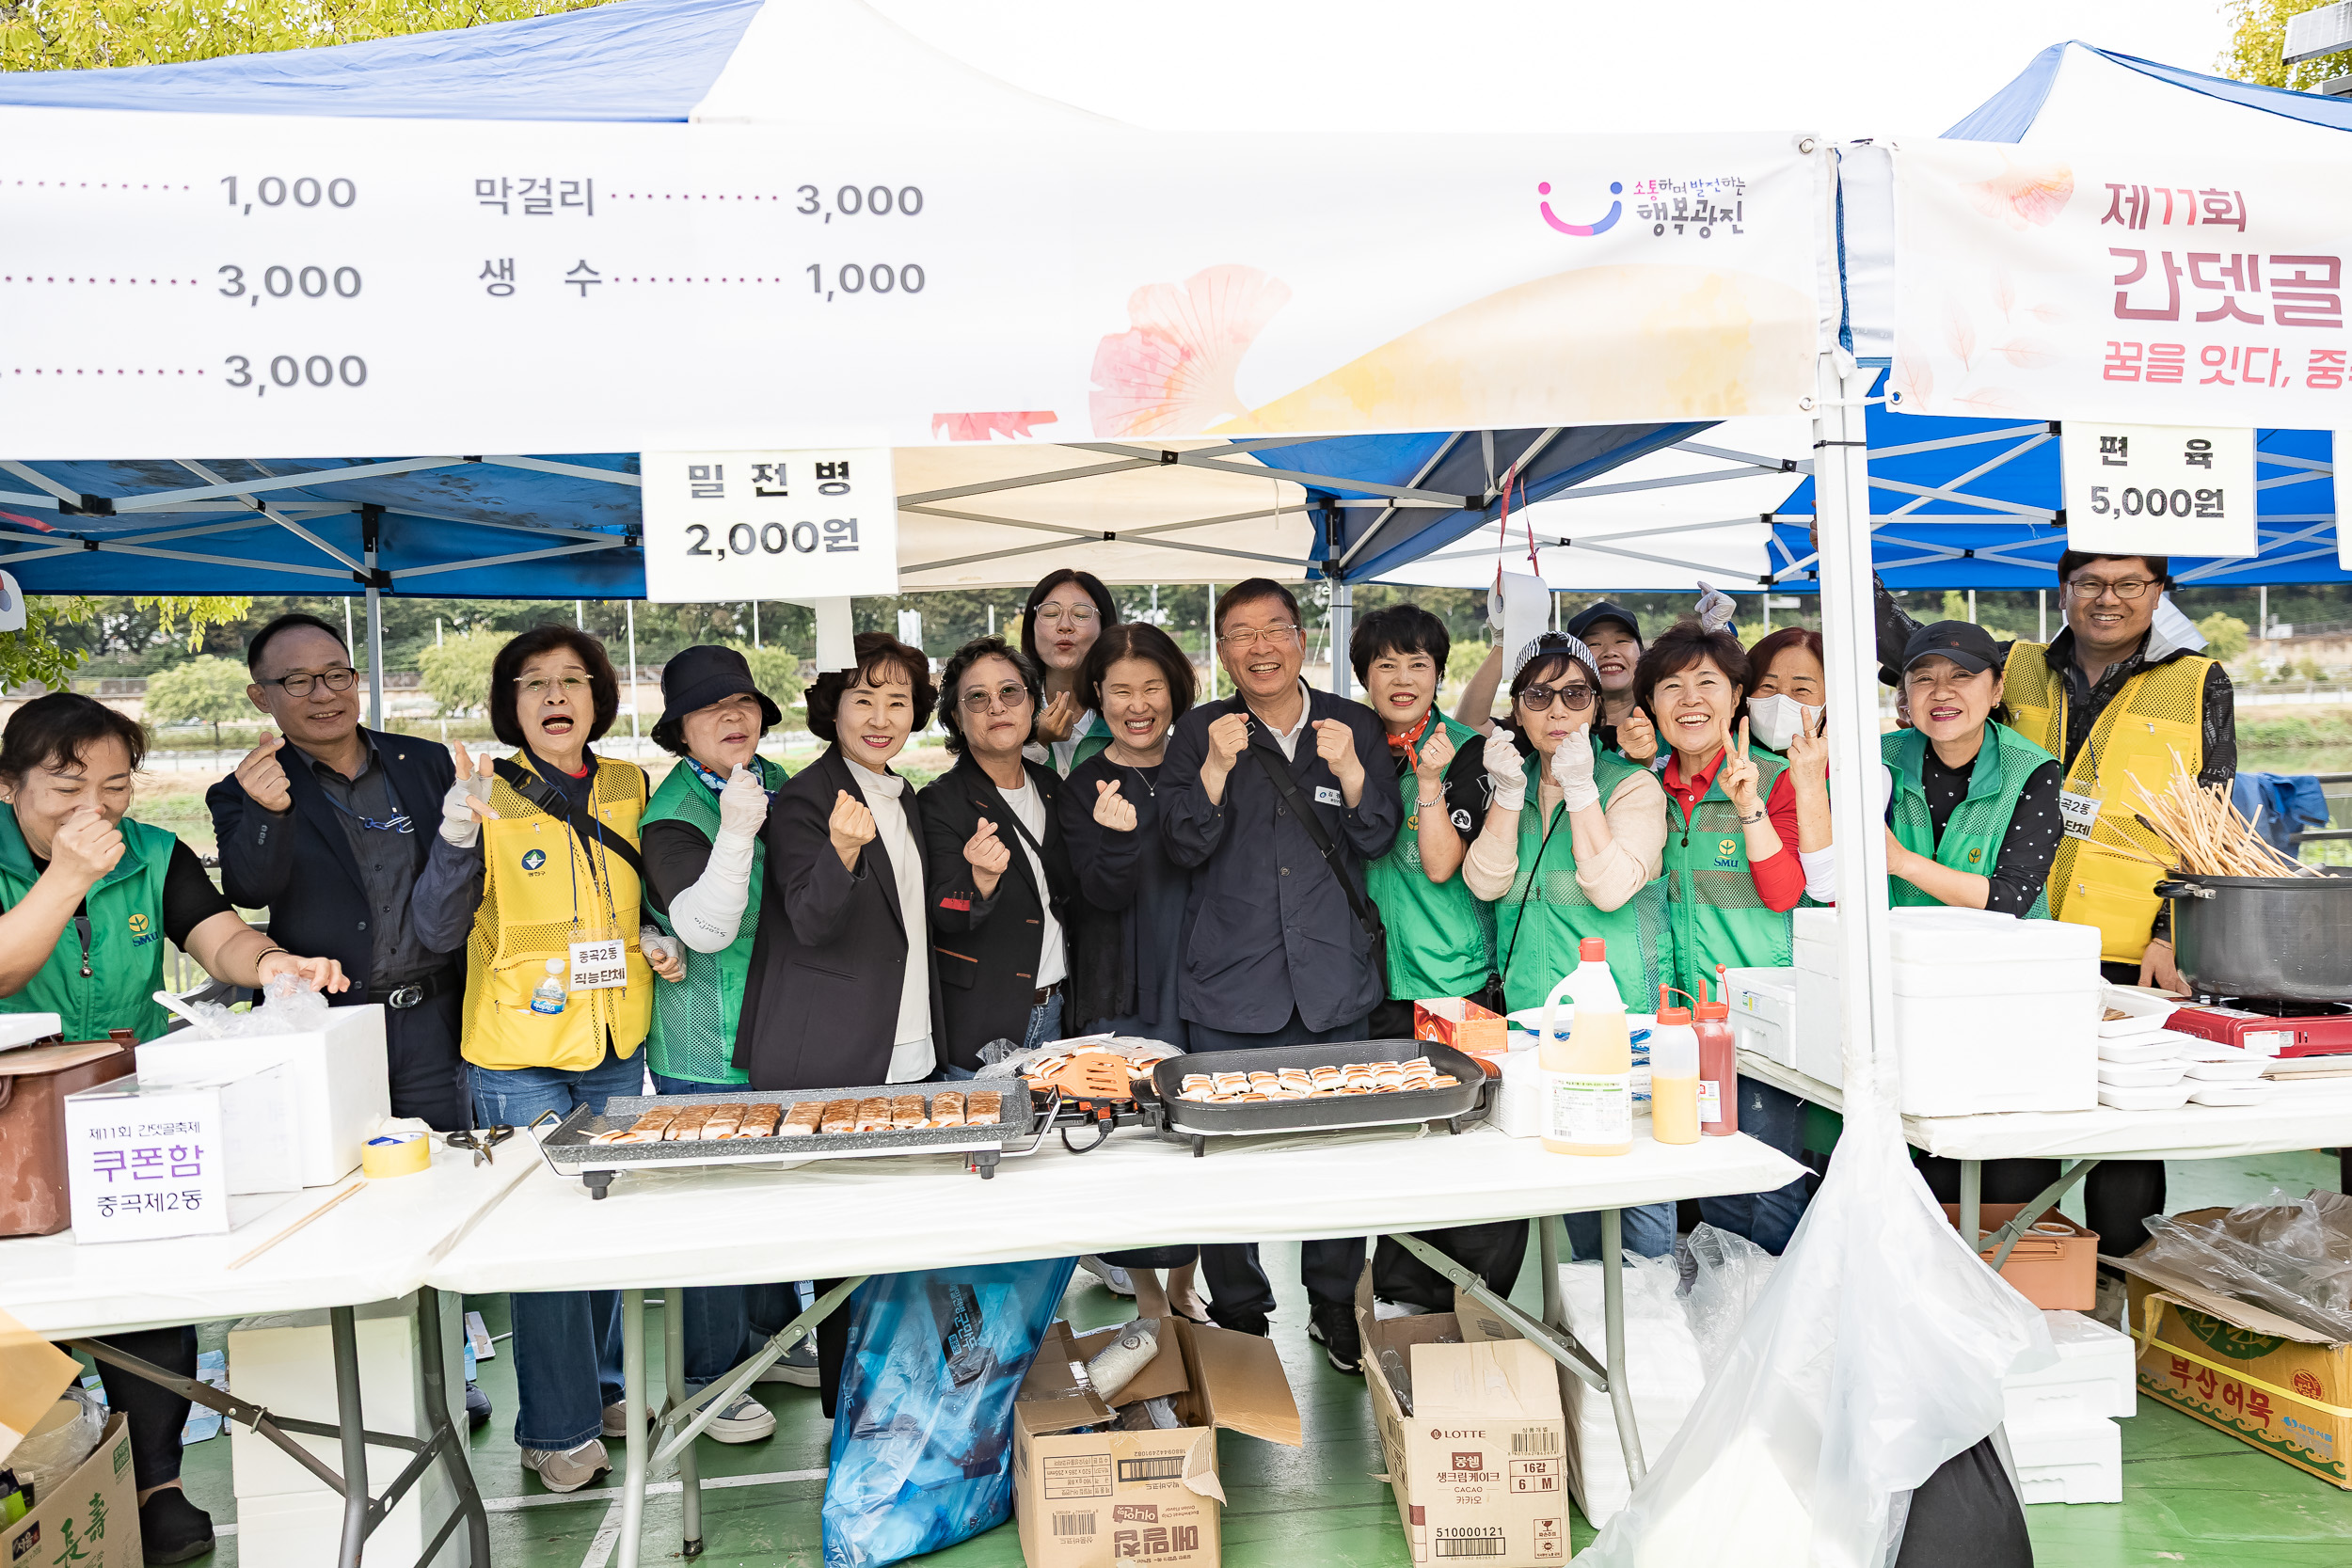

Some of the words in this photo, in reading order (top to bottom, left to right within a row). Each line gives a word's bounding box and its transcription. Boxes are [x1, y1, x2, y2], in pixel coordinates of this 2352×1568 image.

[220, 175, 357, 216] 1,000
[475, 177, 594, 216] 막걸리
[1633, 178, 1688, 201] 소통하며
[1690, 176, 1746, 198] 발전하는
[797, 184, 924, 224] 3,000
[2101, 182, 2248, 232] 제11회
[1636, 197, 1744, 239] 행복광진
[217, 264, 362, 308] 3,000
[806, 263, 925, 302] 1,000
[2108, 246, 2344, 328] 간뎃골
[2103, 341, 2185, 384] 꿈을
[2199, 344, 2291, 388] 잇다,
[2306, 349, 2352, 389] 중
[224, 355, 368, 398] 3,000
[2090, 485, 2224, 520] 5,000원
[685, 517, 859, 562] 2,000원
[2060, 798, 2090, 816] 곡2동
[2064, 820, 2090, 836] 단체
[1713, 858, 1739, 868] SMU
[132, 931, 159, 947] SMU
[579, 946, 617, 964] 중곡2동
[574, 968, 626, 985] 직능단체
[89, 1127, 132, 1140] 제11회
[137, 1121, 201, 1137] 간뎃골축제
[93, 1144, 204, 1183] 쿠폰함
[97, 1189, 202, 1218] 중곡제2동
[954, 1313, 977, 1352] 군만두
[1444, 1430, 1486, 1438] LOTTE
[1454, 1455, 1480, 1469] 몽쉘
[1523, 1463, 1546, 1473] 16갑
[1145, 1481, 1180, 1491] 박스바코드
[1436, 1472, 1501, 1482] 생크림케이크
[1518, 1479, 1526, 1490] 6
[1541, 1478, 1552, 1490] M
[1455, 1496, 1482, 1505] 카카오
[1117, 1506, 1156, 1521] 어니언맛
[1114, 1526, 1199, 1558] 메밀칩
[1436, 1527, 1503, 1538] 510000121
